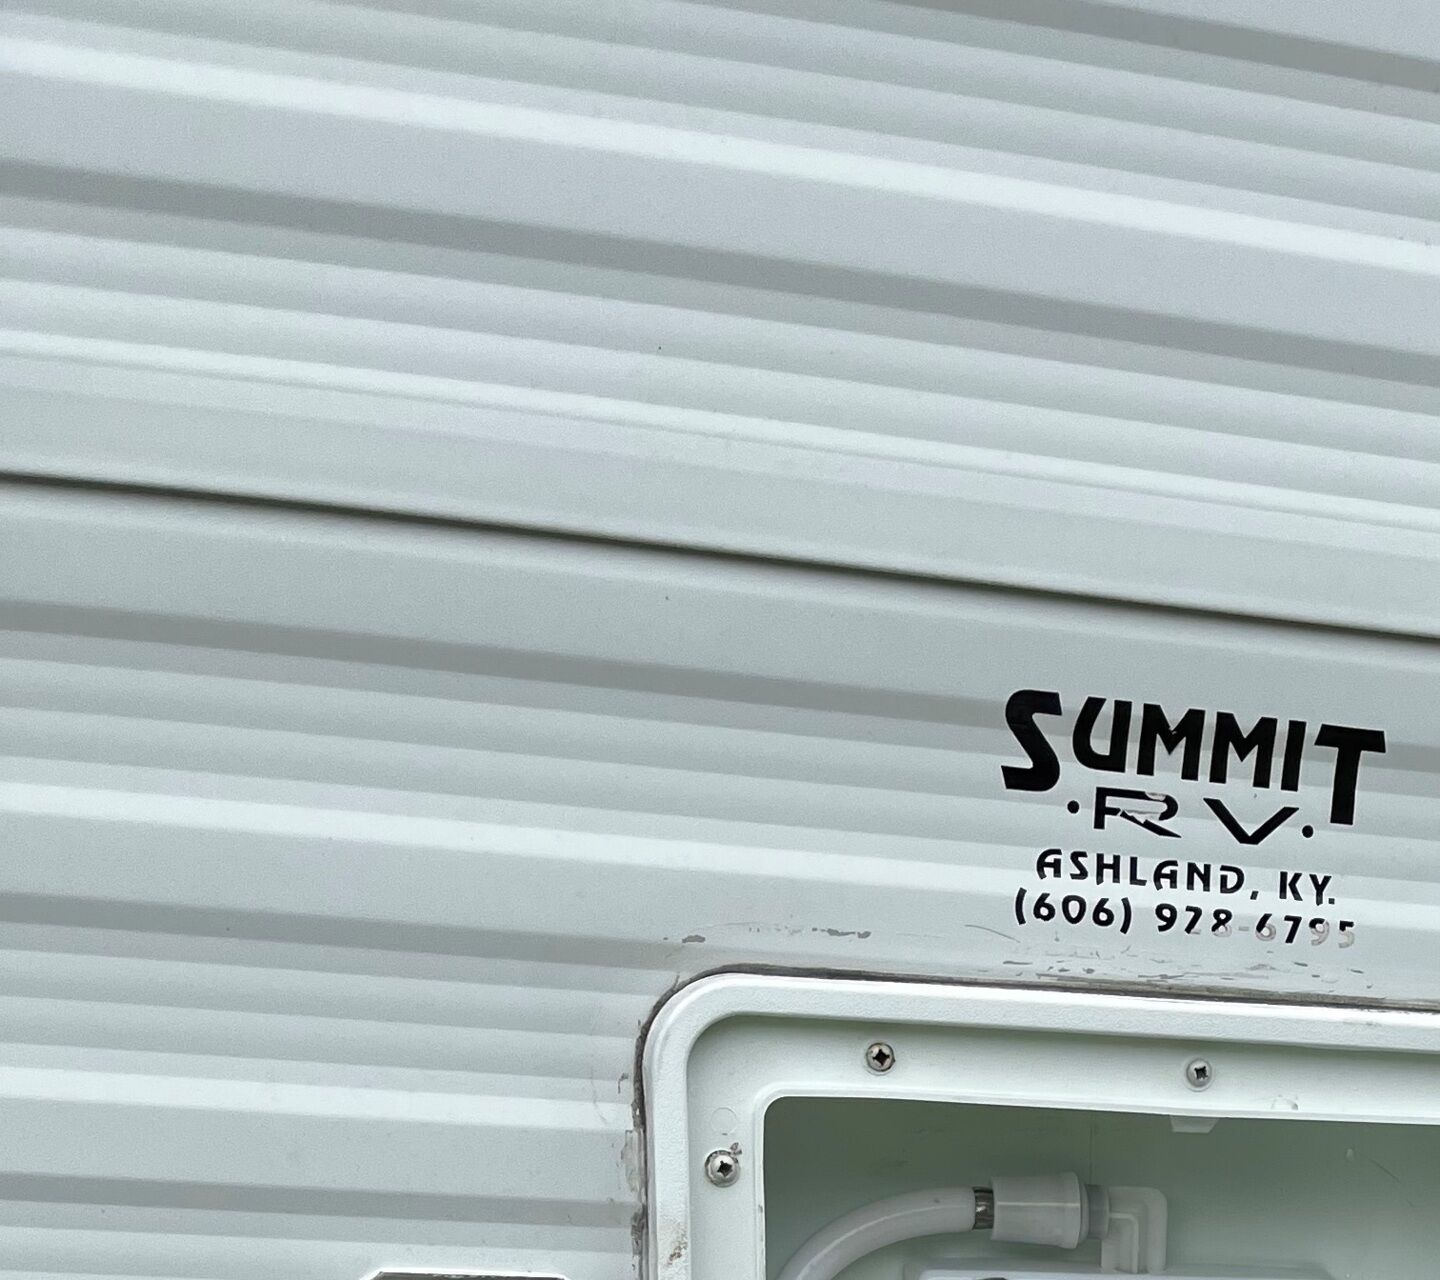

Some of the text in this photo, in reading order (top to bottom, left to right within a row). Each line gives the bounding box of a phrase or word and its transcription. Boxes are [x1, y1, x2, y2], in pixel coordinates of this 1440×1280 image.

[1000, 689, 1388, 826] SUMMIT
[1036, 848, 1336, 906] ASHLAND, KY.
[1014, 887, 1132, 935] (606)
